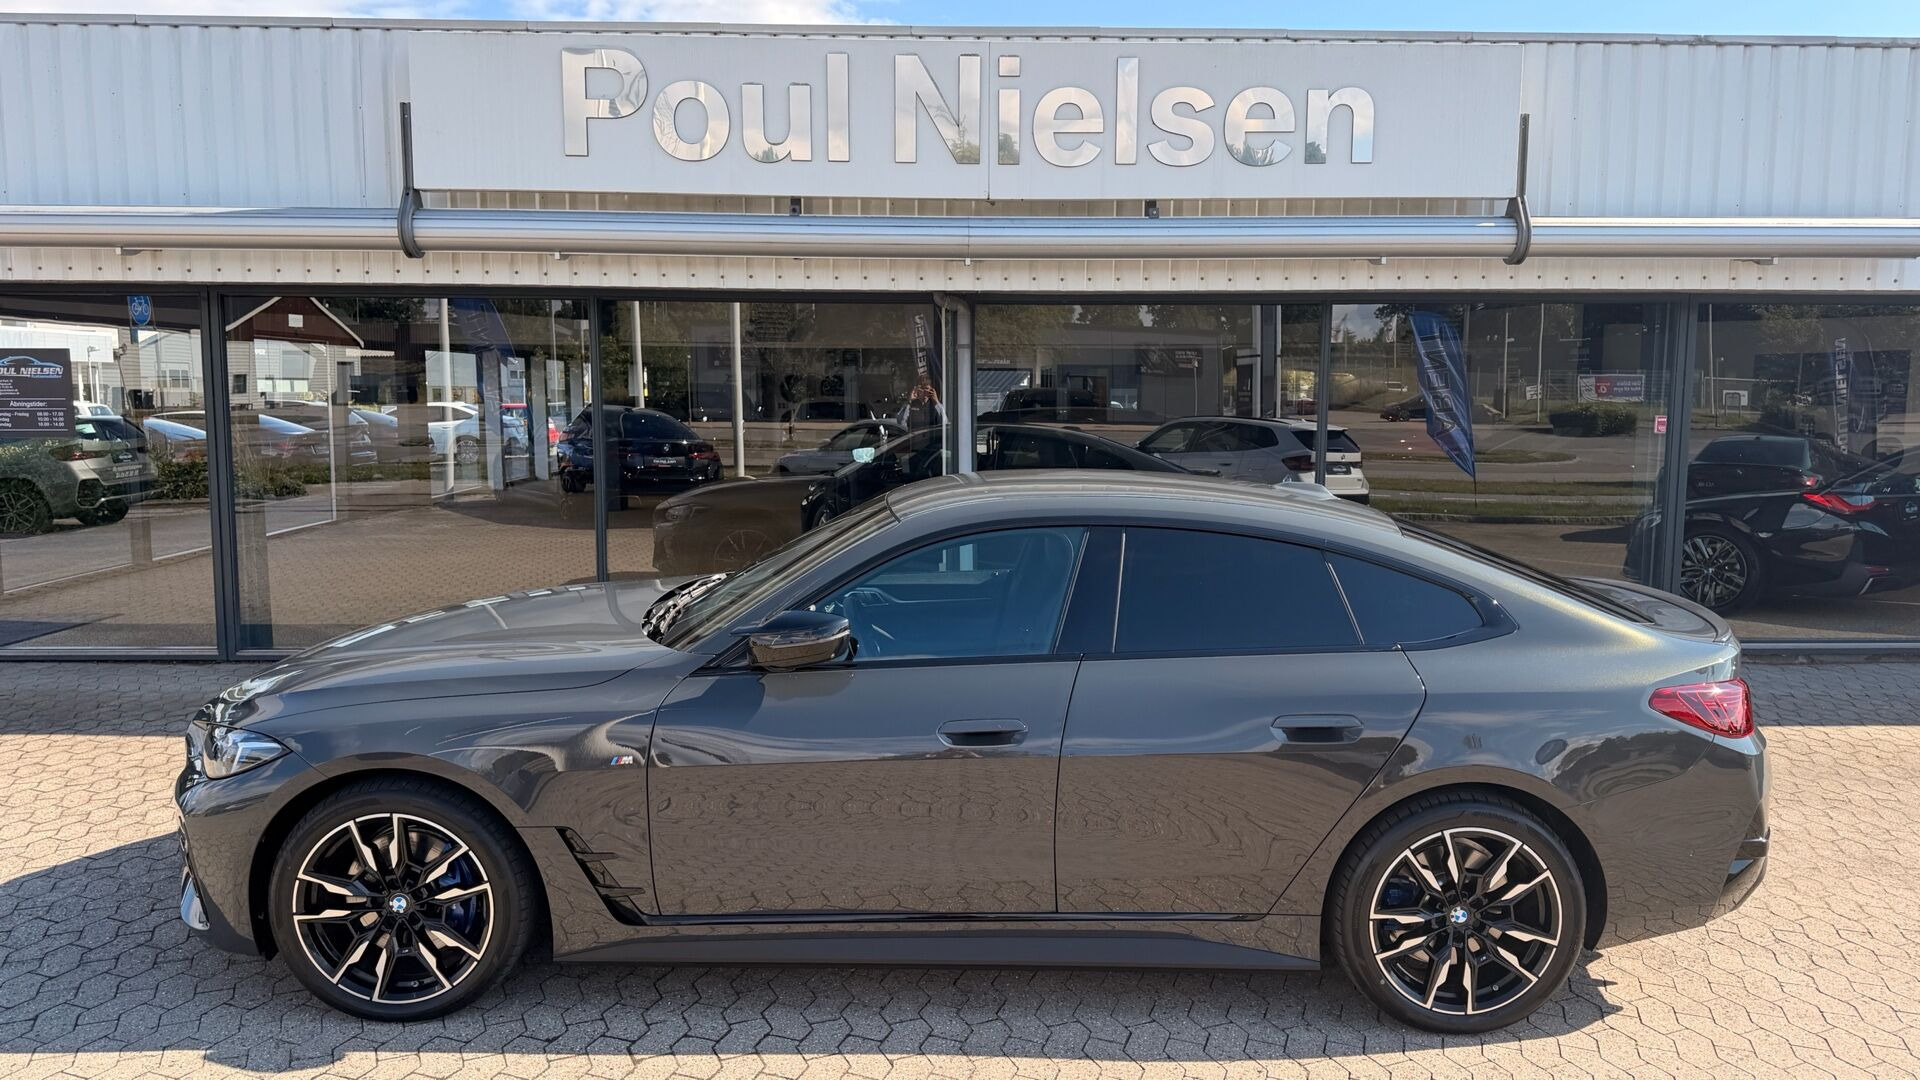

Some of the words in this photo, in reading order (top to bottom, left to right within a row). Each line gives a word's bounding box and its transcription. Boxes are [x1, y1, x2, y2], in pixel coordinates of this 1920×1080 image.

[560, 47, 851, 163] Poul
[893, 53, 1376, 168] Nielsen
[19, 367, 64, 375] NIELSEN
